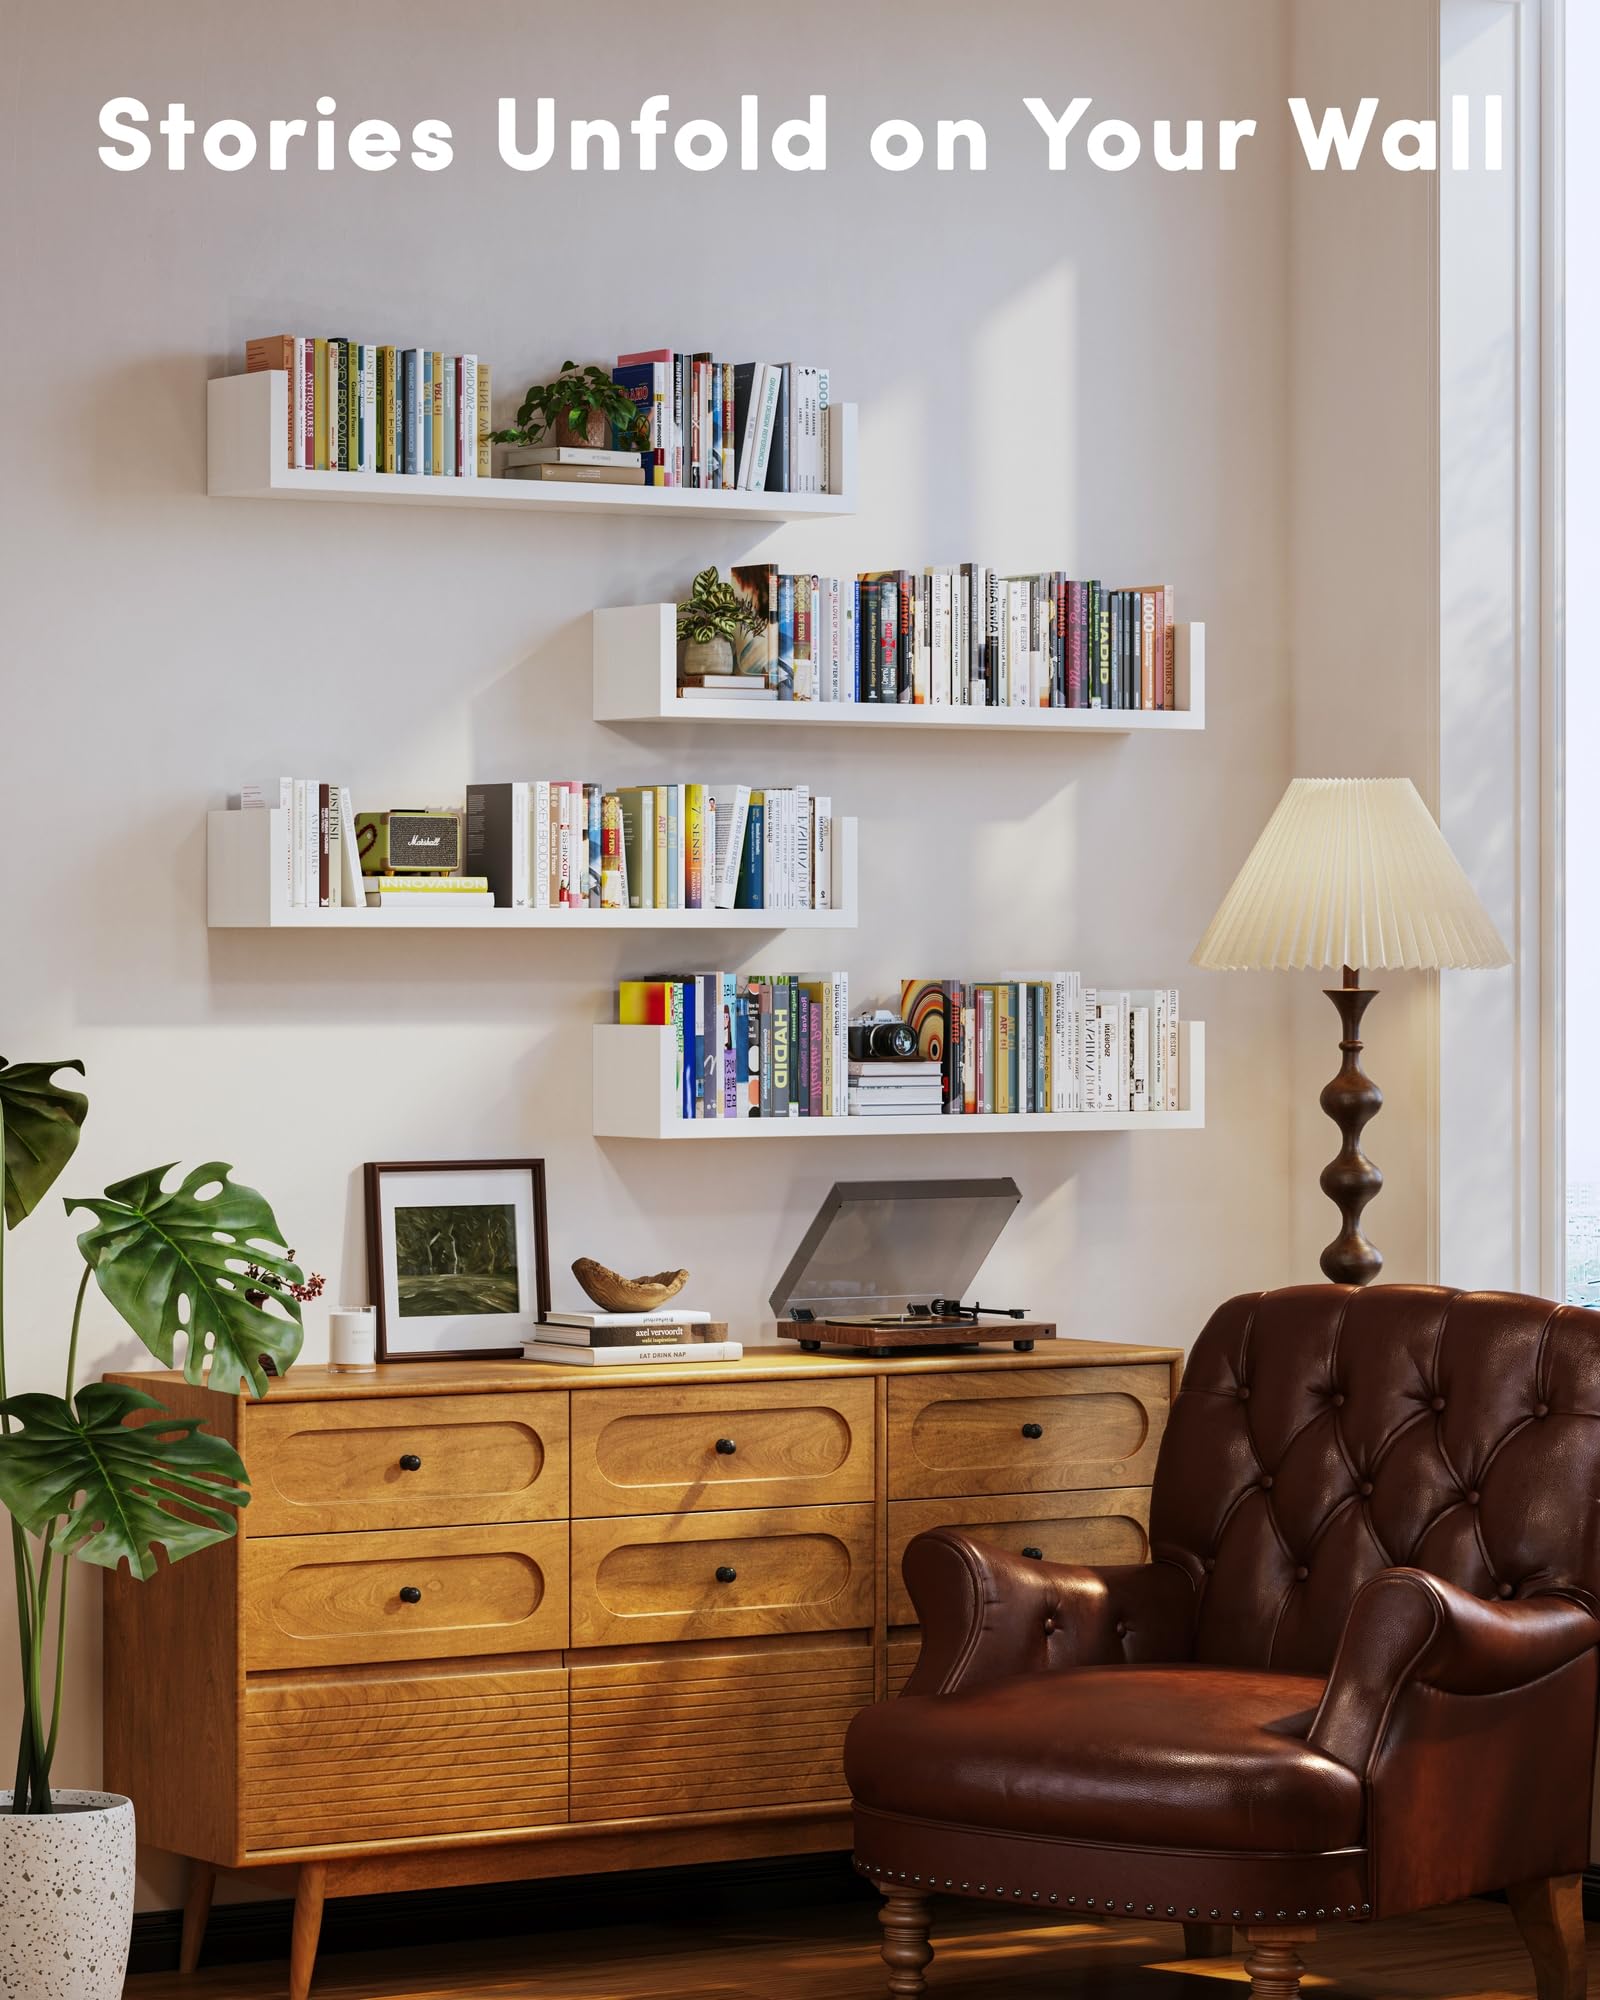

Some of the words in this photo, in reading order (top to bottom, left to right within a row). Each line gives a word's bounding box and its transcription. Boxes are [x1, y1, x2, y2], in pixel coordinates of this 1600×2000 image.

[338, 342, 347, 384] ALEXEY
[767, 378, 776, 403] GRAPHIC
[818, 374, 828, 411] 1000
[338, 389, 347, 463] BRODOVITCH
[763, 405, 772, 427] DESIGN
[757, 428, 767, 468] REFERENCED
[1057, 584, 1065, 637] BAUHAUS
[1070, 583, 1081, 624] Parr
[1143, 597, 1154, 633] 1000
[1070, 631, 1081, 688] Martin
[1100, 612, 1109, 684] HADID
[330, 787, 339, 814] LOST
[538, 785, 548, 826] ALEXEY
[330, 817, 339, 840] FISH
[735, 806, 744, 834] MOVIES
[408, 834, 440, 846] Marshall
[538, 830, 548, 900] BRODOVITCH
[728, 850, 738, 884] METHODS
[381, 878, 486, 889] INNOVATION
[636, 1329, 650, 1337] axel
[651, 1327, 683, 1336] vervoordt
